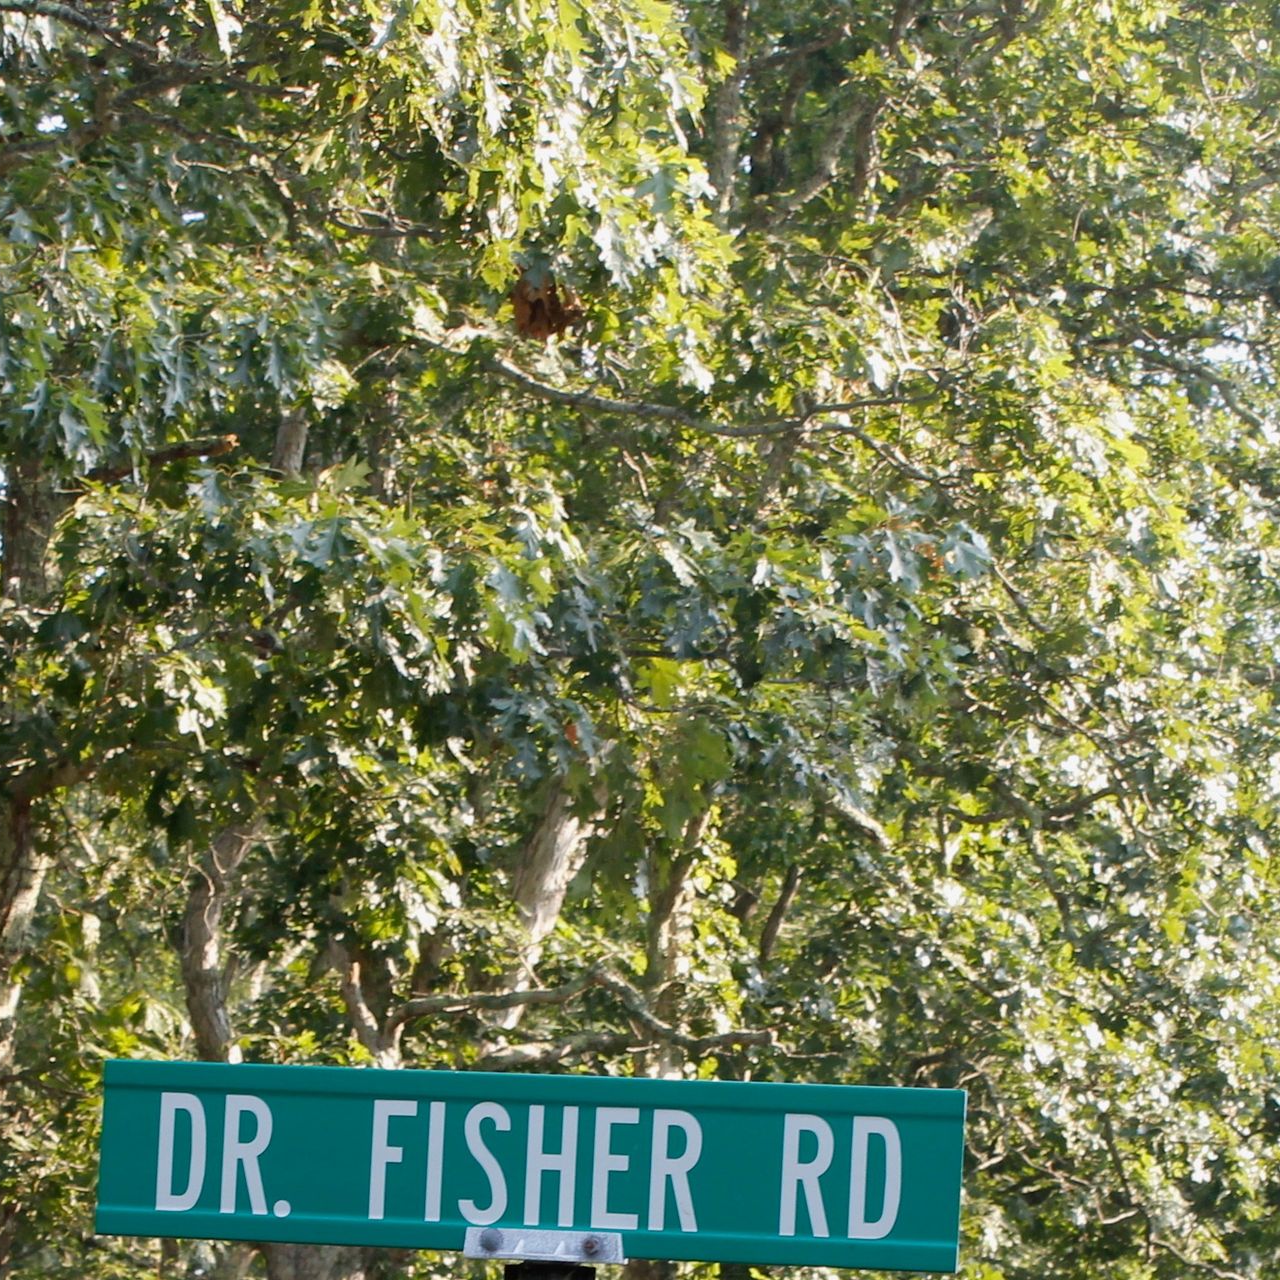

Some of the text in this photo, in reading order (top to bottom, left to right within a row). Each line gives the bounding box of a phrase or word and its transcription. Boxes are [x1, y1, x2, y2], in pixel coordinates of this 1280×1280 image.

[154, 1091, 902, 1240] DR. FISHER RD
